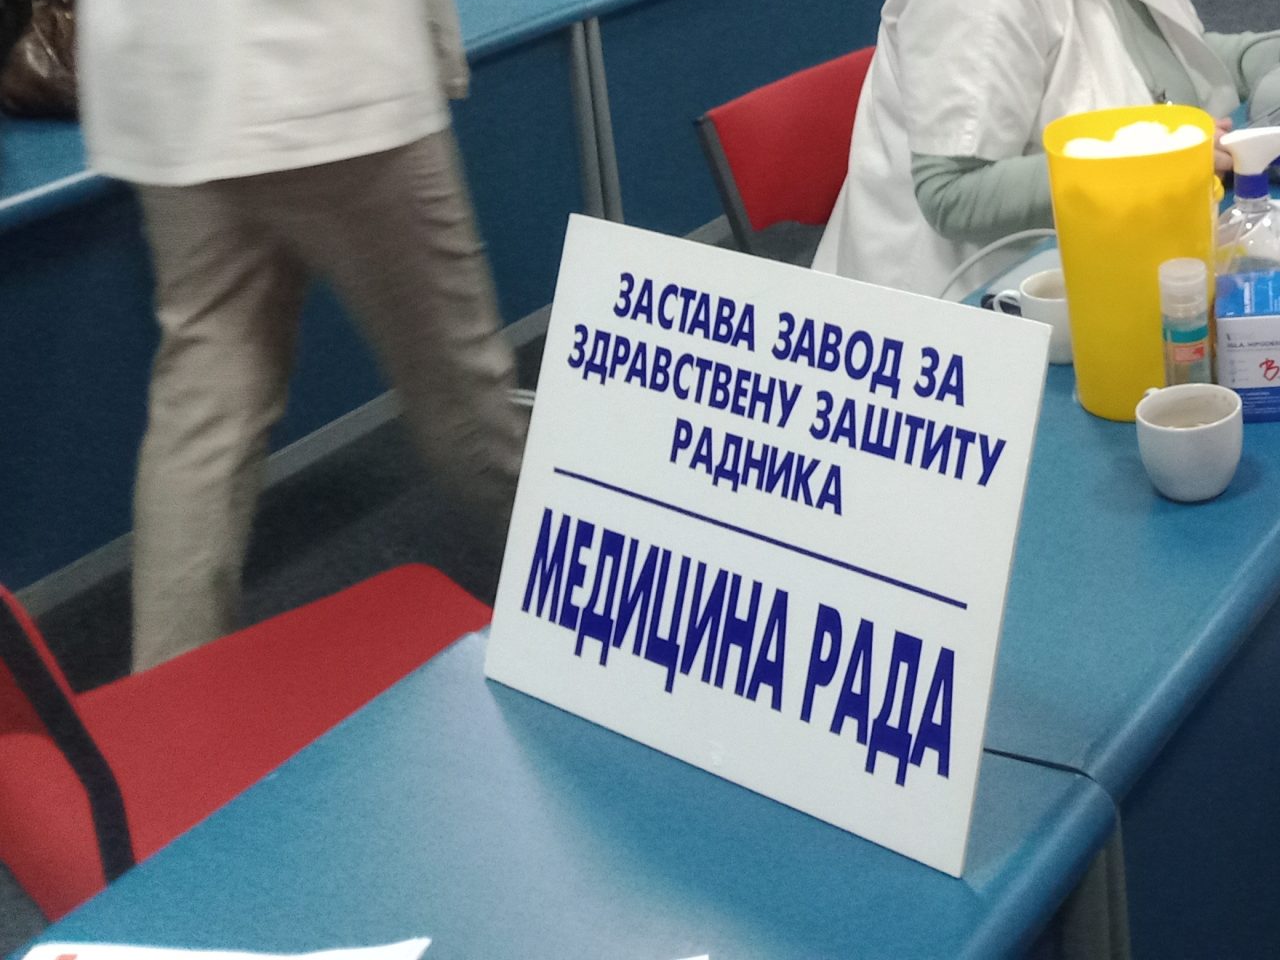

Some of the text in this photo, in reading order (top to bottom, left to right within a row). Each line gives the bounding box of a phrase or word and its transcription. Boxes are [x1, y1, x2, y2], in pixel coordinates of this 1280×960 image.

[567, 323, 1006, 486] ЗДРАВСТВЕНУ ЗАШТИТУ
[613, 271, 965, 407] ЗАСТАВА ЗАВОД ЗА
[670, 418, 843, 516] РАДНИКА
[521, 507, 956, 787] МЕДИЦИНА РАДА
